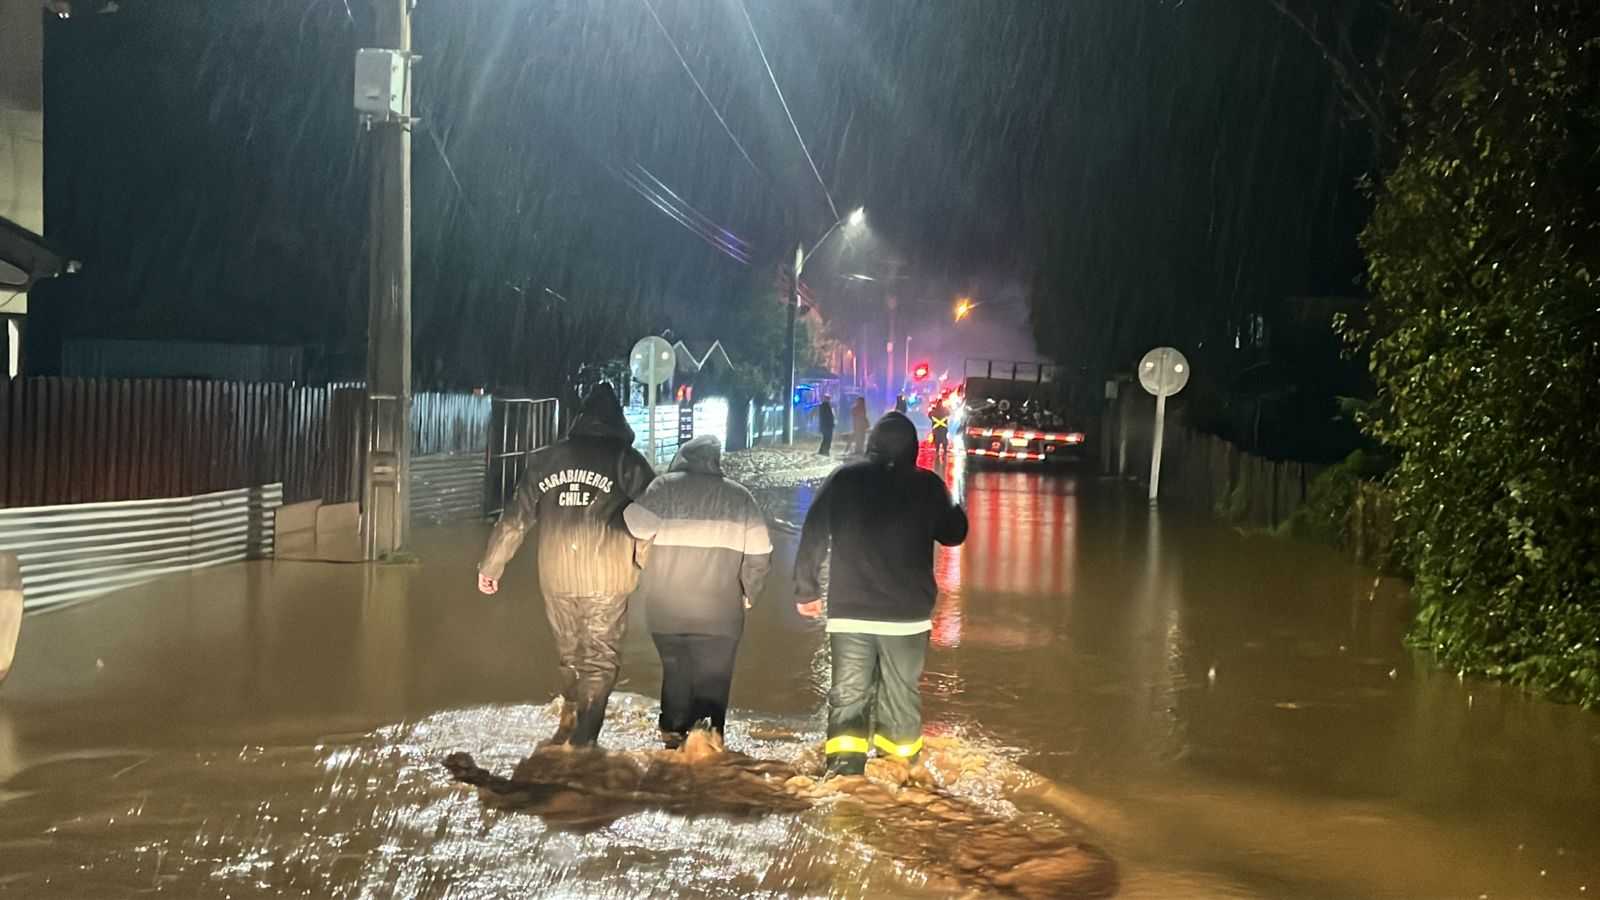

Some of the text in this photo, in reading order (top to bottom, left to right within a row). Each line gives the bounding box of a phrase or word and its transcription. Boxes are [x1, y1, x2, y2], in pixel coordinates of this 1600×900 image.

[538, 469, 614, 493] CARABINEROS
[569, 483, 580, 492] DE
[558, 491, 591, 506] CHILE
